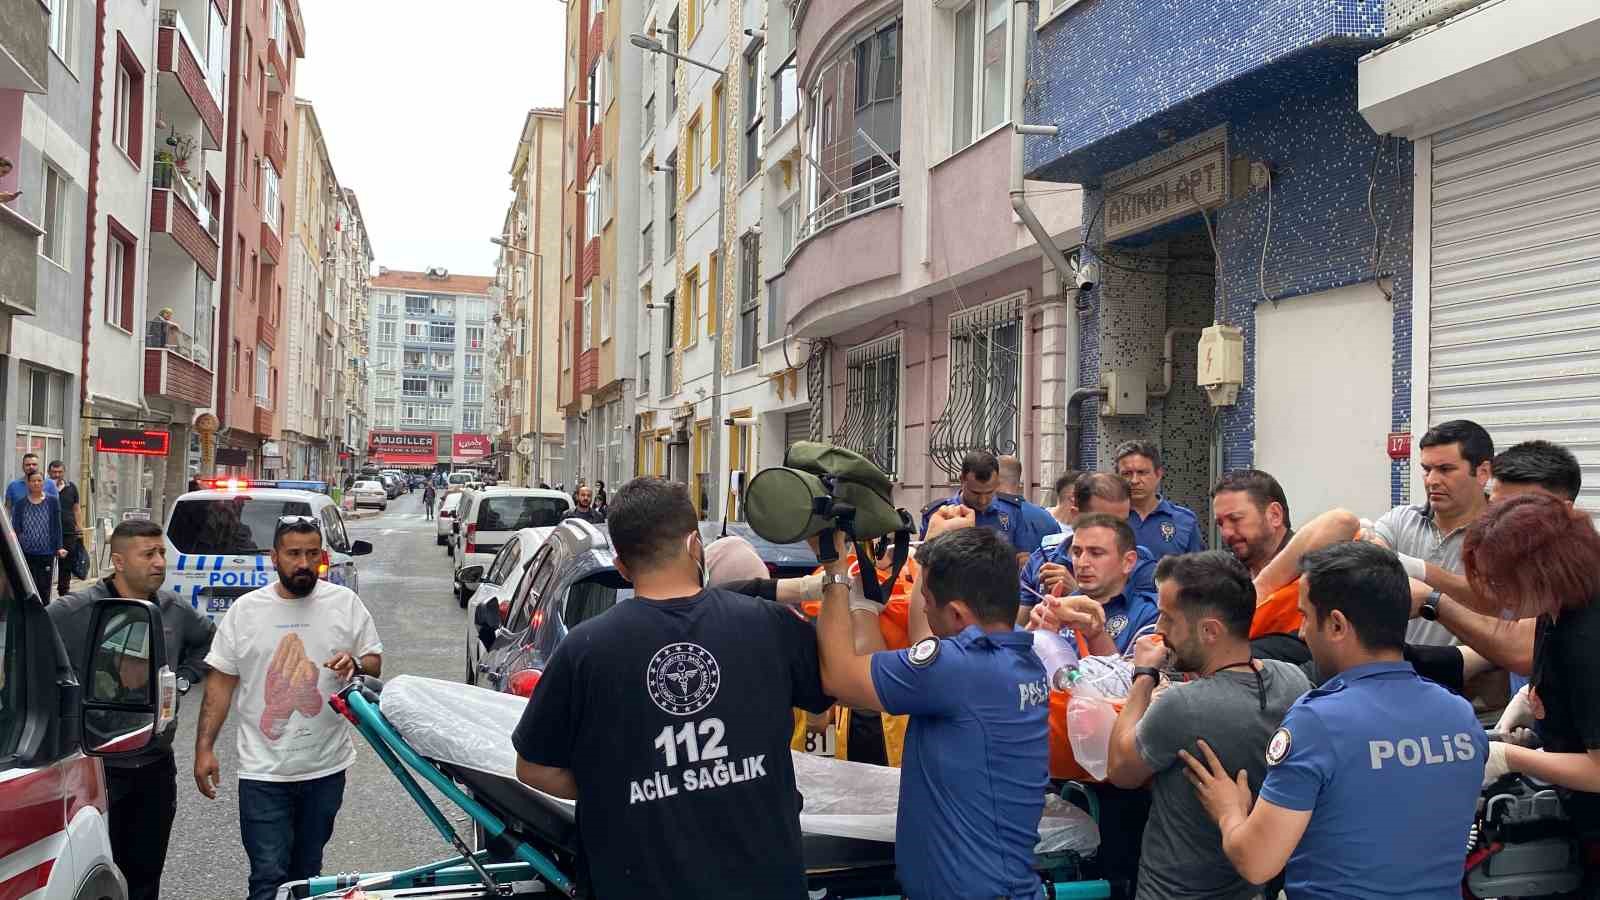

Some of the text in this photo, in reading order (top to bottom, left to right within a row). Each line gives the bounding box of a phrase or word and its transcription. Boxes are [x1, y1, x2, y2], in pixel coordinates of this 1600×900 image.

[210, 569, 268, 586] POLİS
[213, 598, 224, 608] 59
[654, 718, 728, 767] 112
[630, 754, 767, 804] ACİL SAĞLIK
